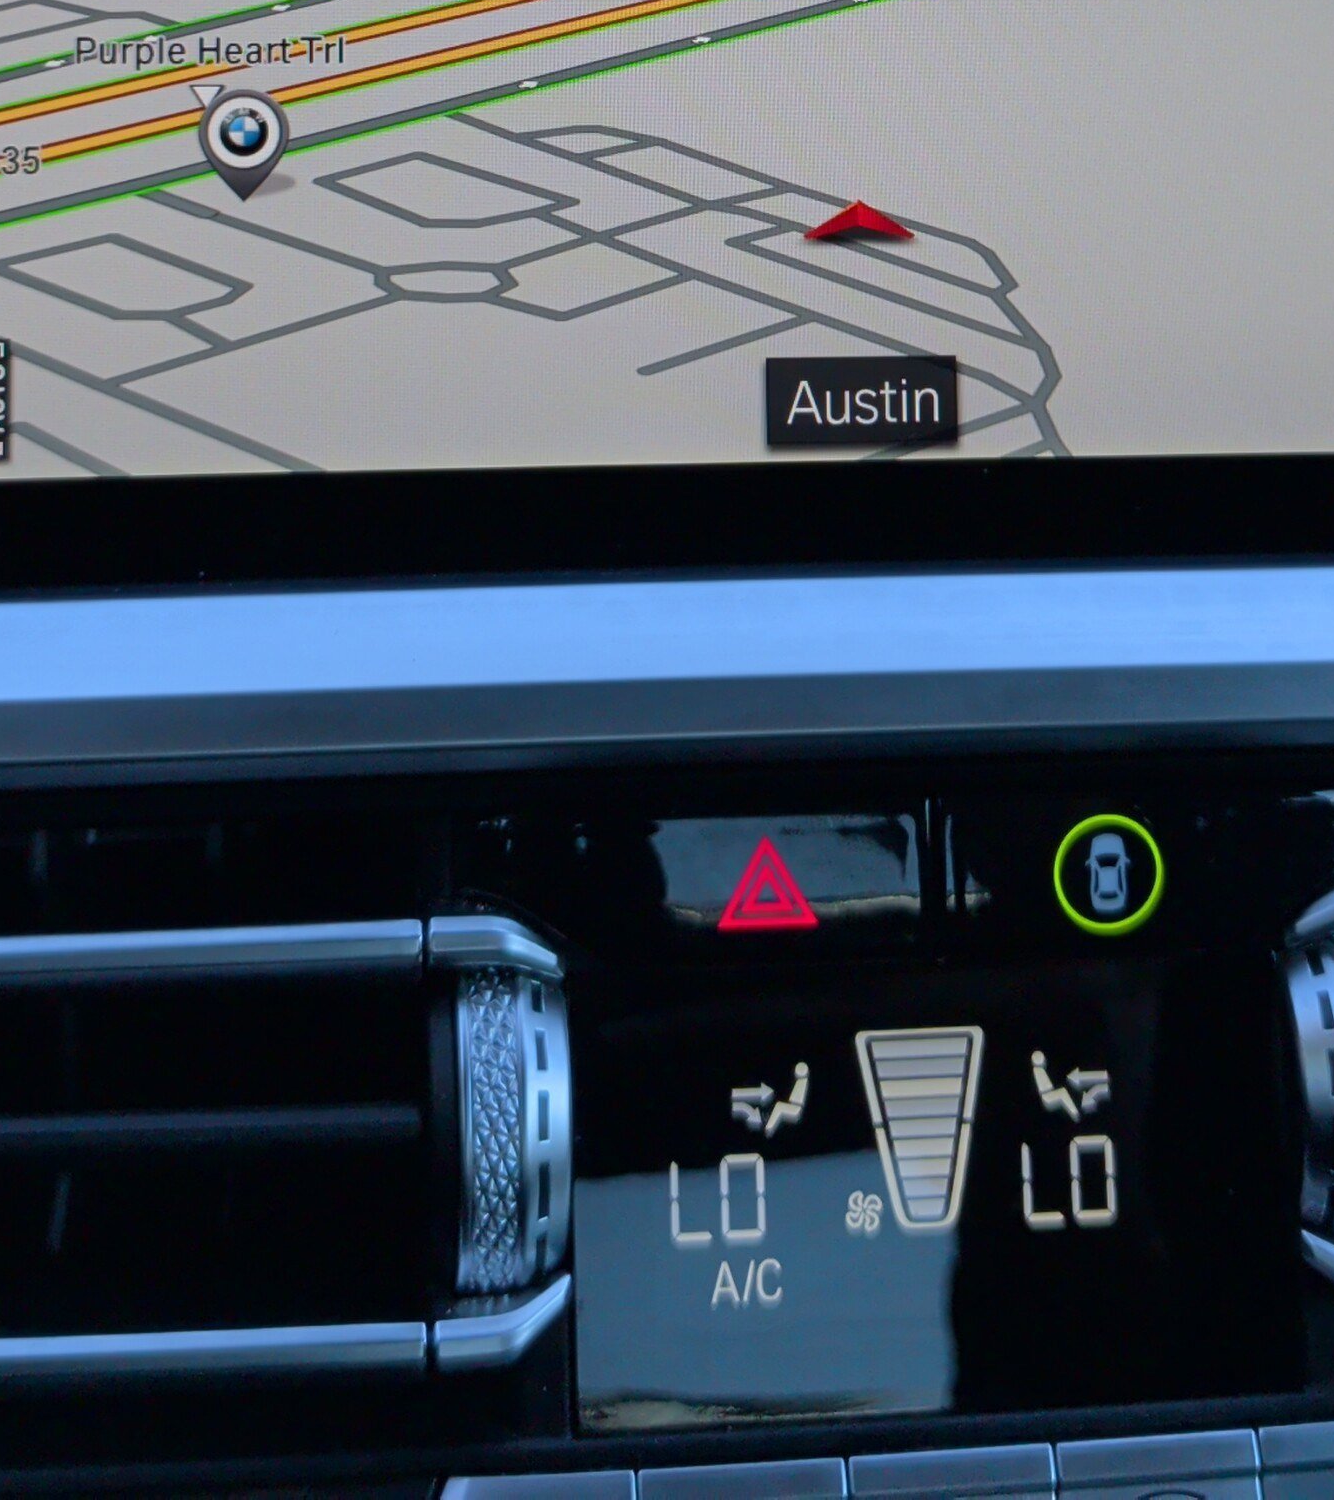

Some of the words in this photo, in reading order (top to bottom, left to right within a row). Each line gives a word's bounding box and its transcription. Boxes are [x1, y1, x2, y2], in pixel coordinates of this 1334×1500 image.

[75, 37, 186, 70] Purple
[198, 37, 291, 64] Heart
[305, 37, 344, 64] Trl
[786, 378, 940, 425] Austin
[711, 1258, 783, 1306] A/C
